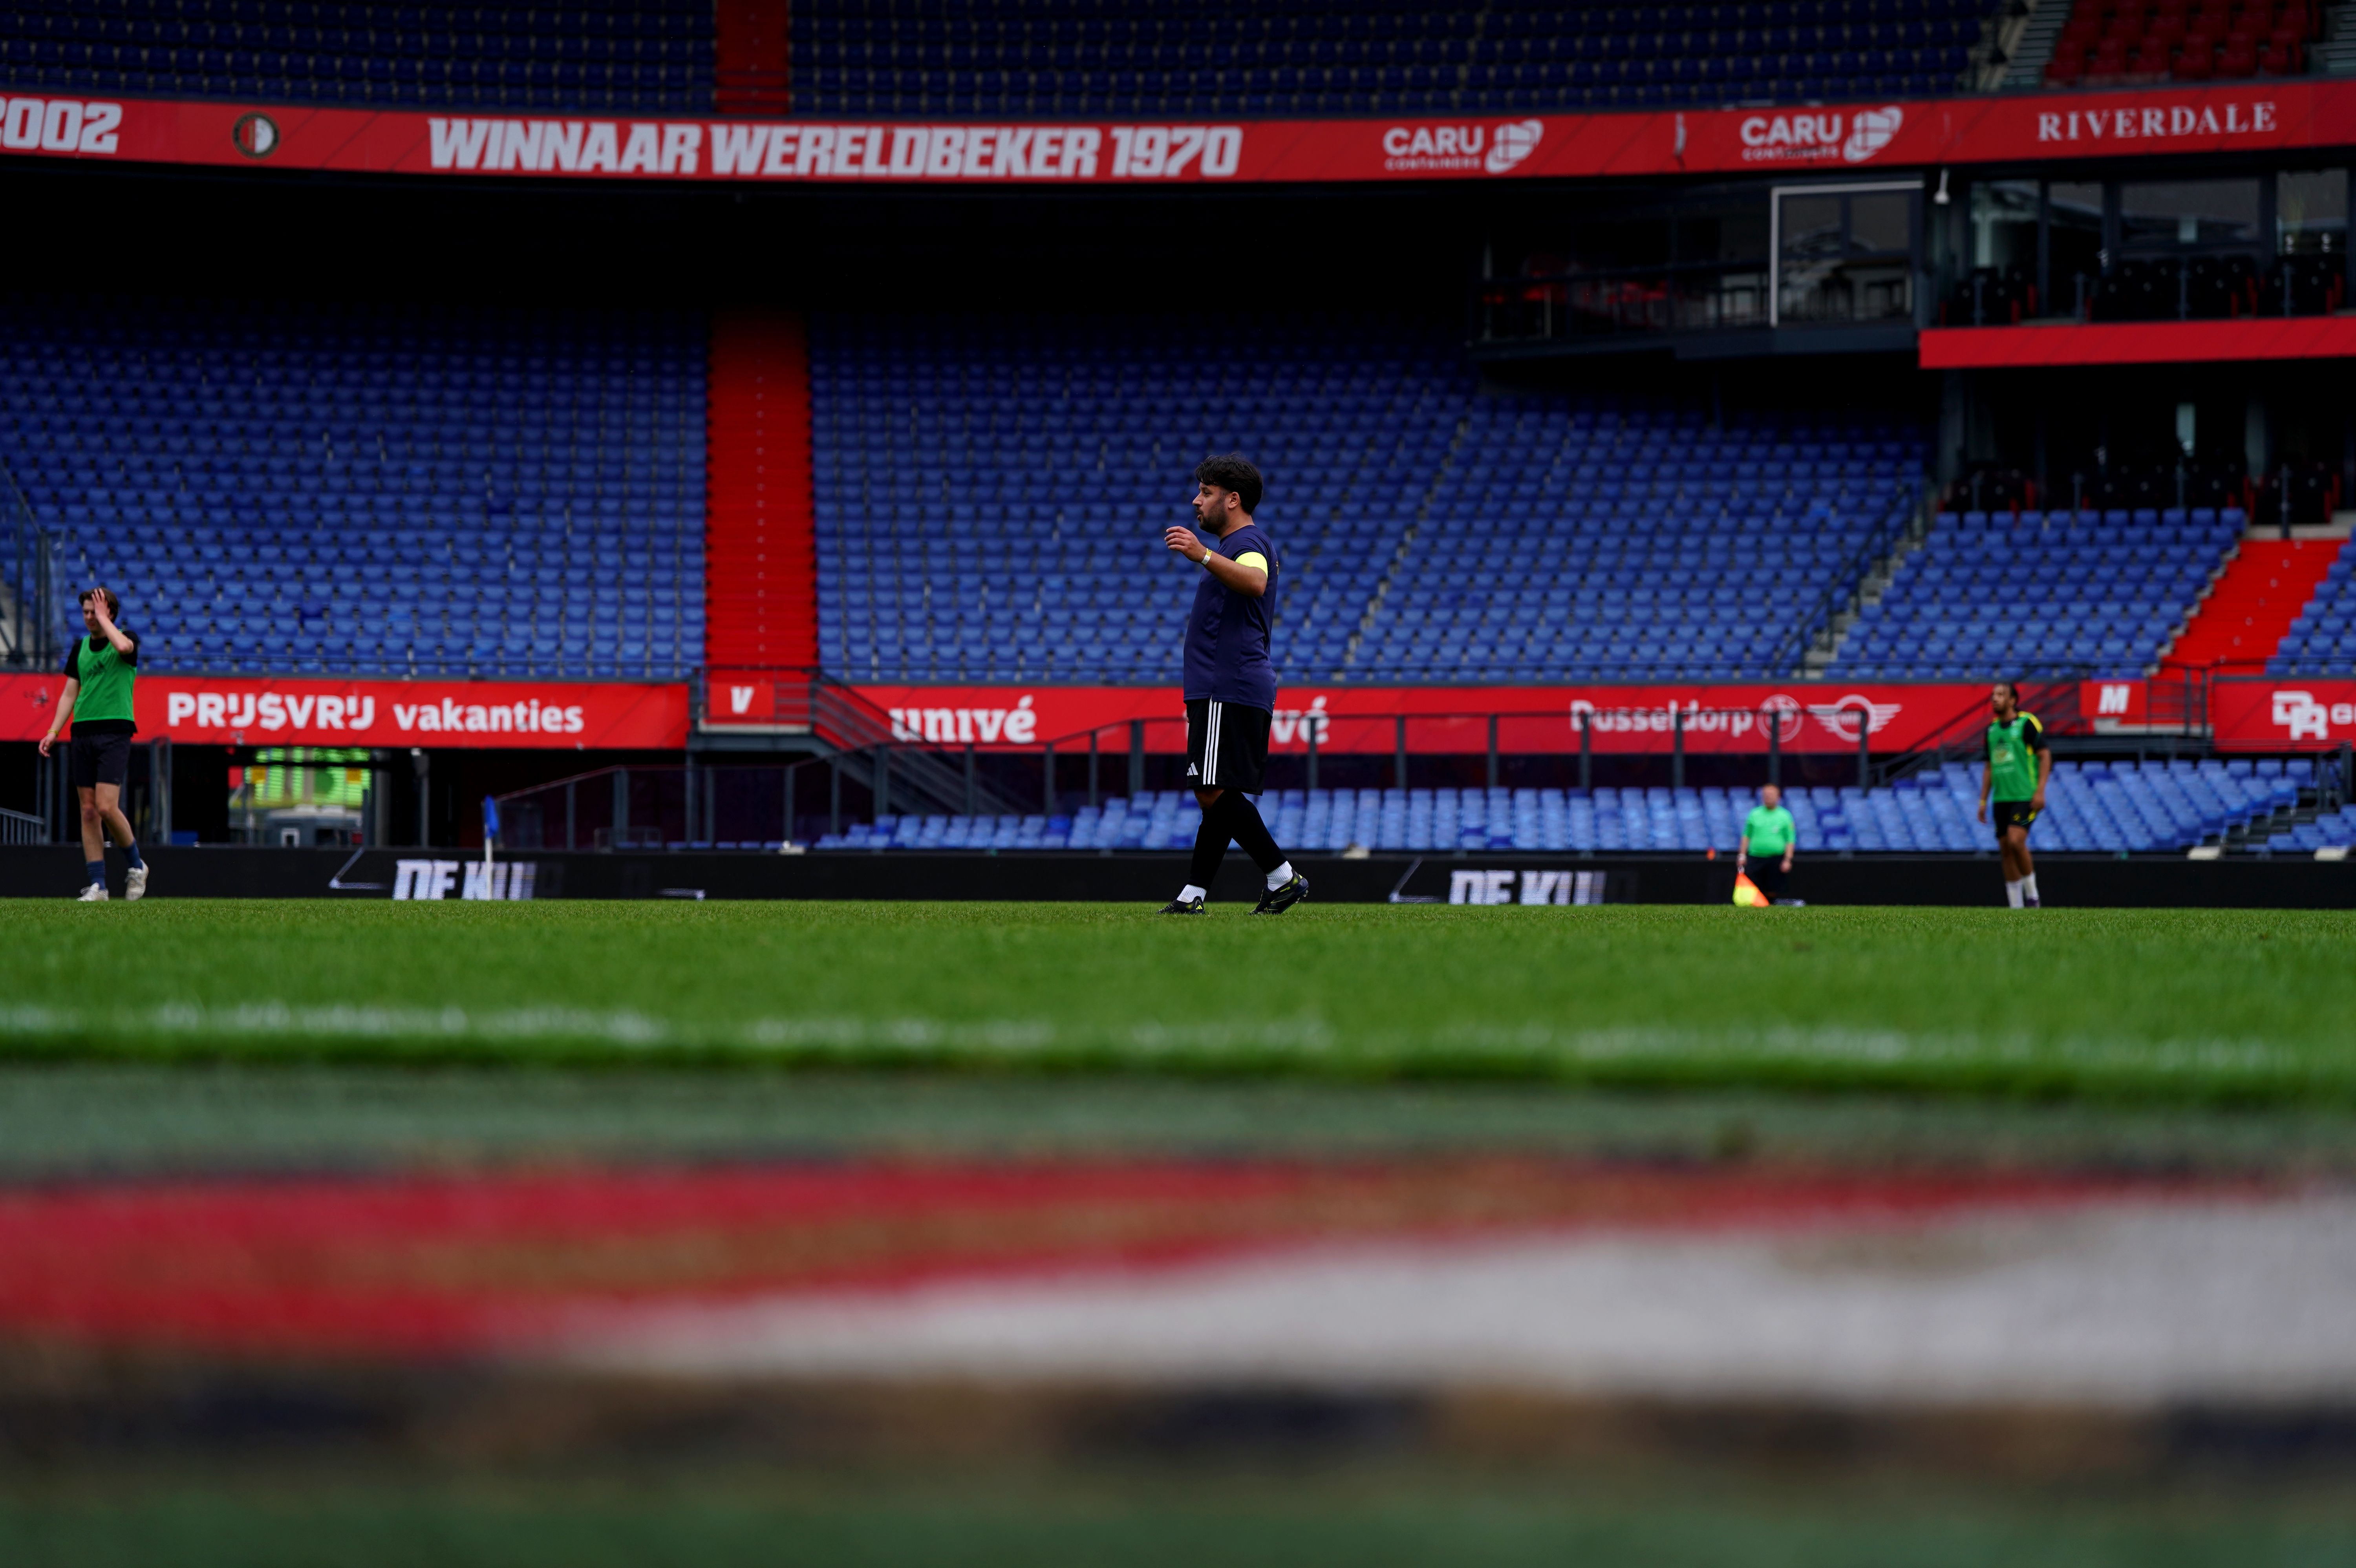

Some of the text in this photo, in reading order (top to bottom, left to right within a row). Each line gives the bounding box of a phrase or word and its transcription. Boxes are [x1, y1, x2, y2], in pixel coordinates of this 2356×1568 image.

[0, 97, 123, 154] 002
[1740, 114, 1842, 146] CARU
[2037, 101, 2277, 141] RIVERDALE
[428, 117, 1242, 177] WINNAAR WERELDBEKER 1970
[1383, 125, 1484, 156] CARU
[393, 698, 584, 733] vakanties
[731, 686, 754, 713] V
[2098, 684, 2129, 713] M
[888, 694, 1037, 744] univé
[1570, 699, 1754, 737] Dusseldorp
